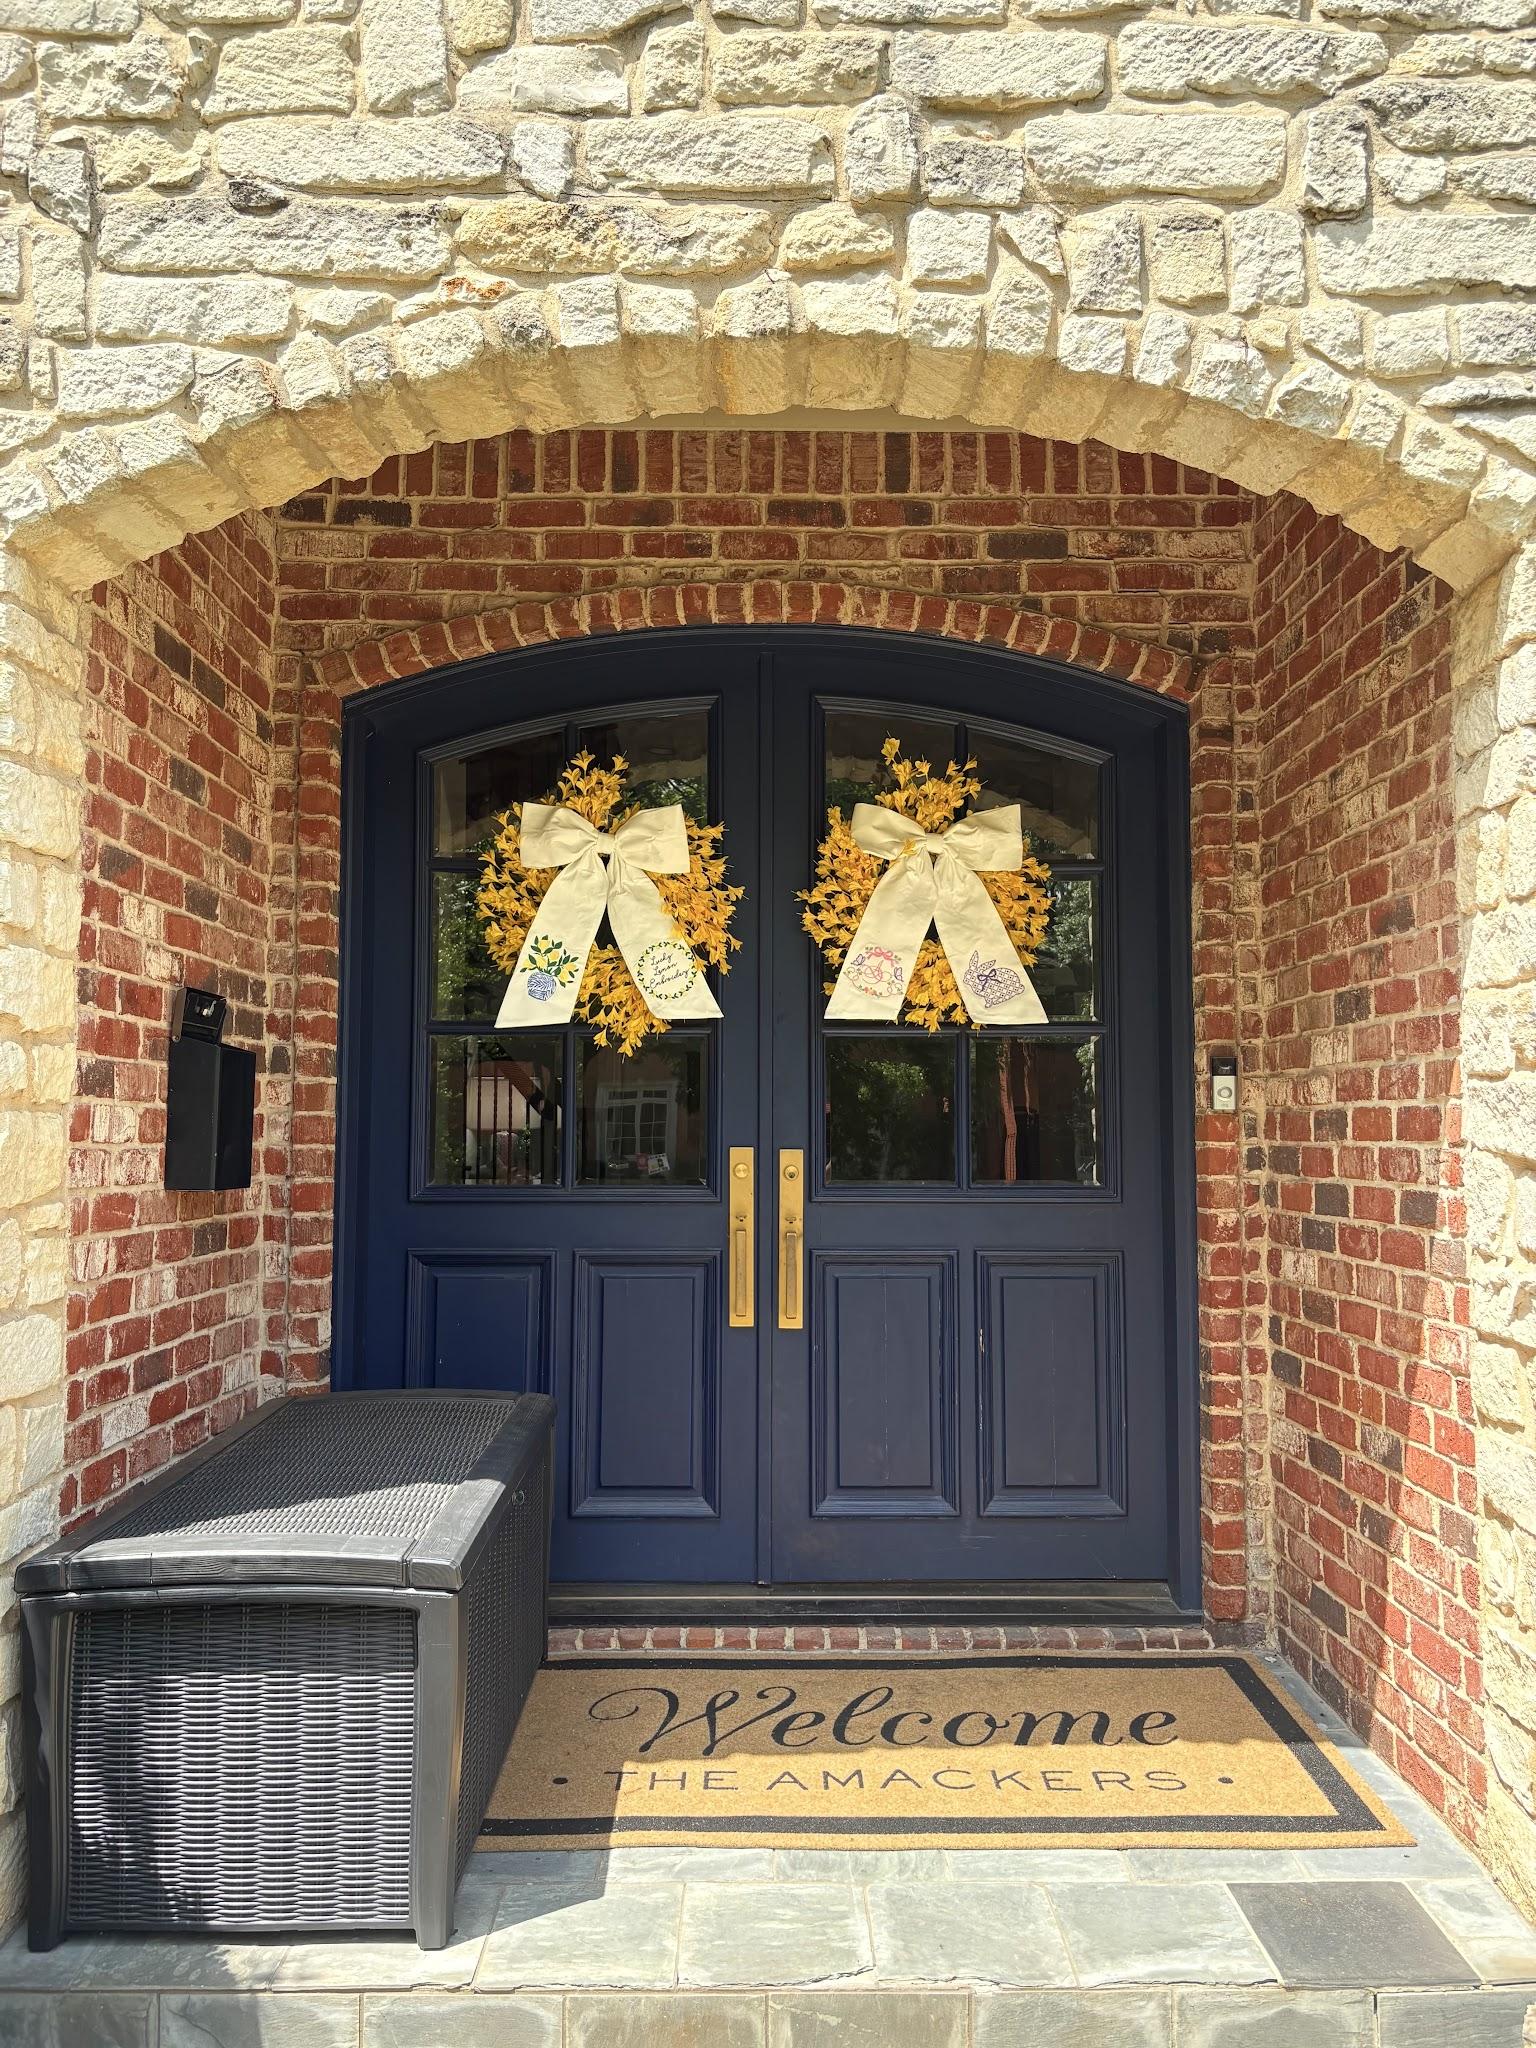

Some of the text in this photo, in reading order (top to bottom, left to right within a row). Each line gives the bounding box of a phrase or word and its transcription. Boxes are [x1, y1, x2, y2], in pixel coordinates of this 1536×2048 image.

[651, 953, 672, 965] Lucky
[588, 1686, 1178, 1756] Welcome
[604, 1769, 1187, 1791] THE AMACKERS
